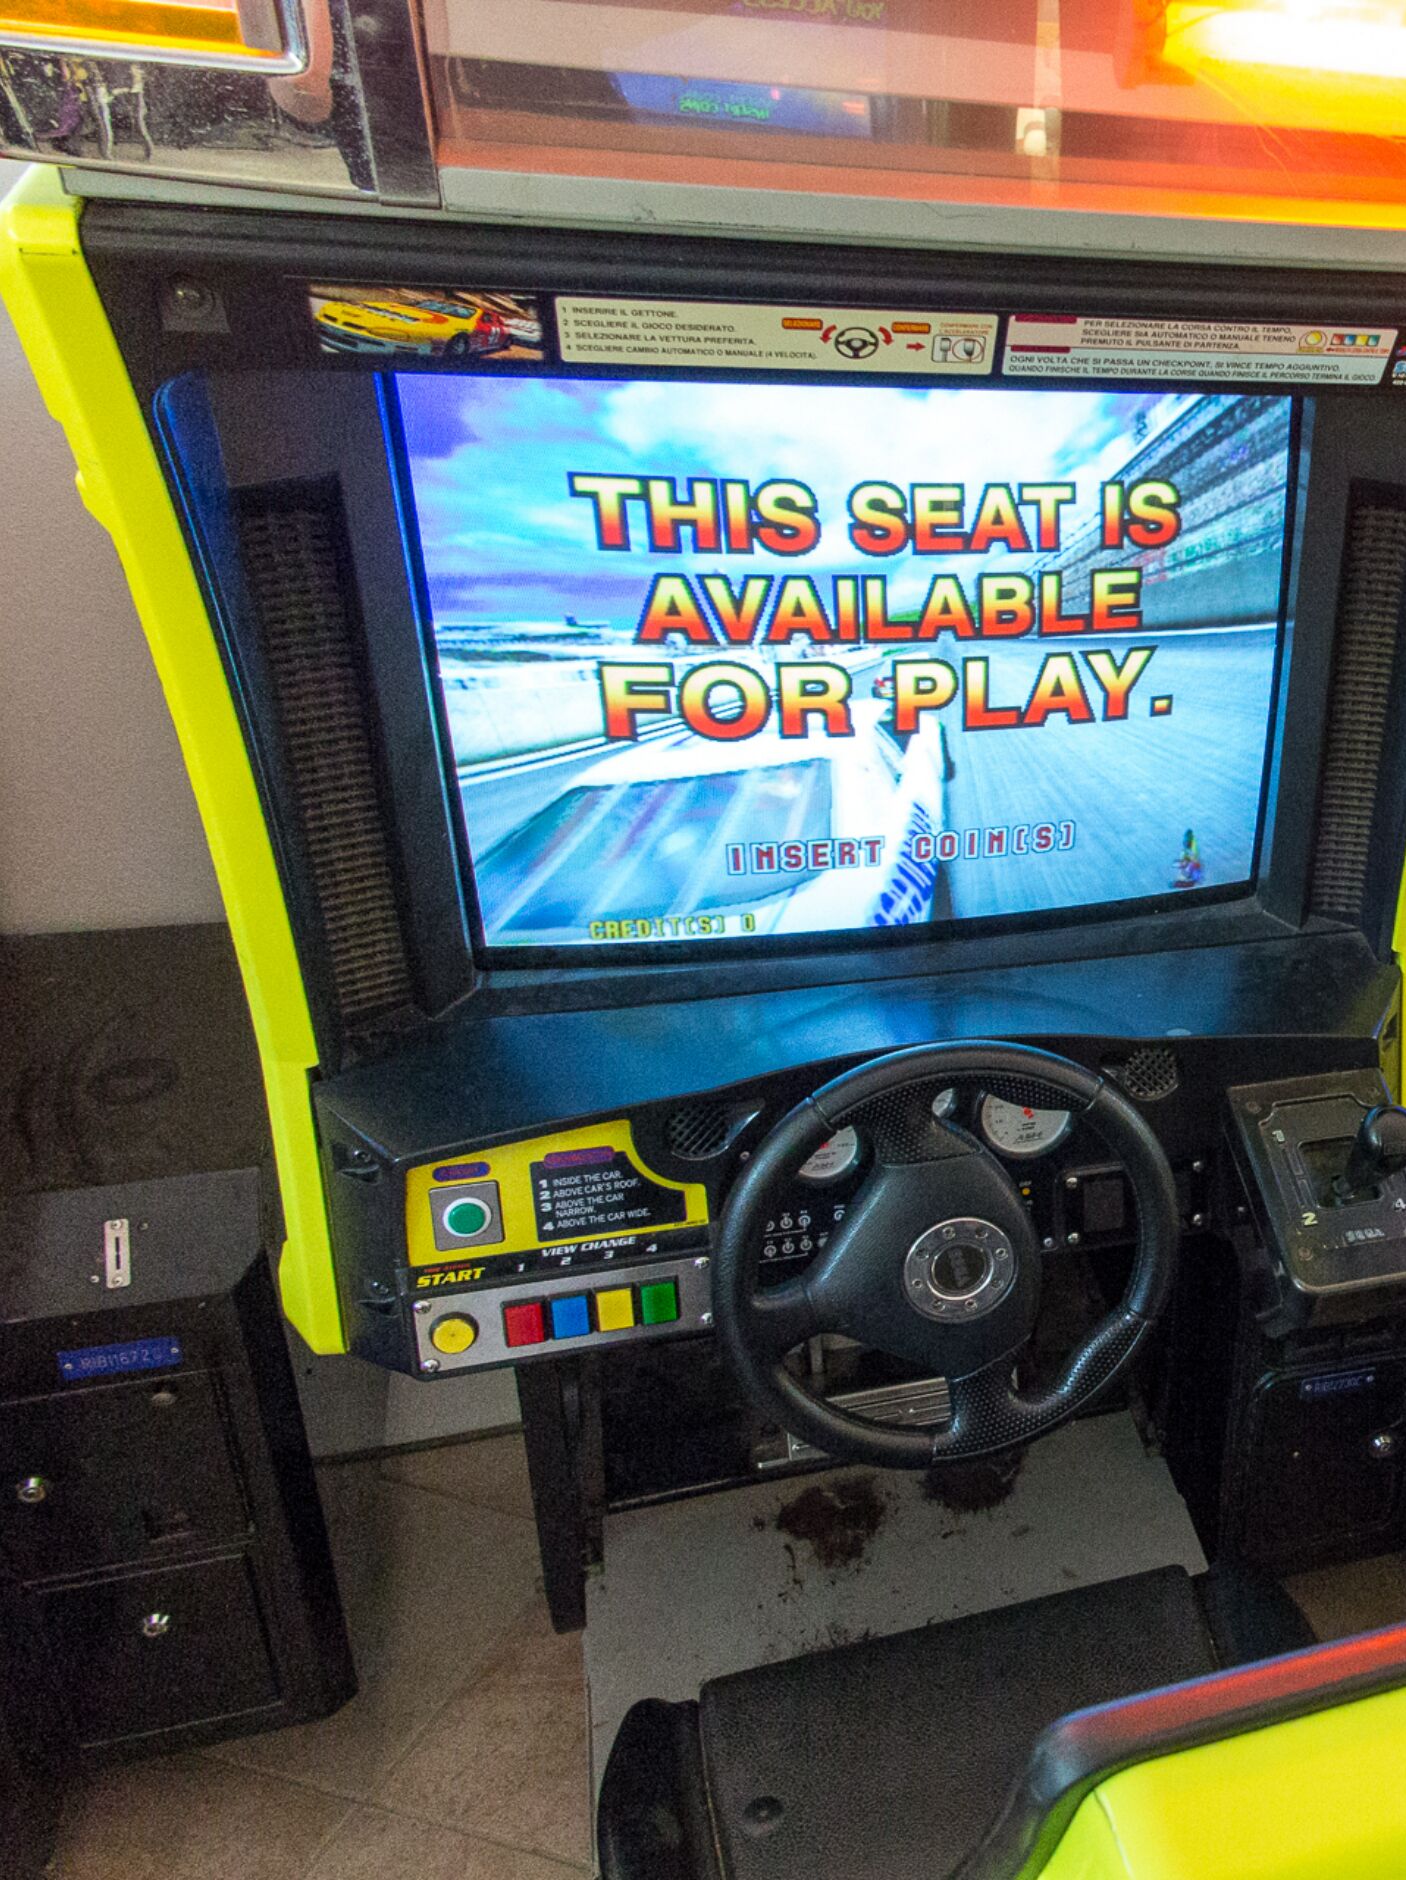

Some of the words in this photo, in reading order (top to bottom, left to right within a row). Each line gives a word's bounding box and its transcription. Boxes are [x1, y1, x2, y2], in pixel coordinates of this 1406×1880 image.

[572, 306, 618, 316] INSERIRE
[574, 320, 628, 329] SCEGLIERE
[642, 322, 673, 330] GIOCO
[1084, 320, 1101, 328] PER
[1105, 320, 1165, 330] SELEZIONARE
[1181, 323, 1212, 332] CORSA
[1214, 324, 1250, 333] CONTRO
[575, 332, 642, 341] SELEZIONARE
[659, 335, 702, 343] VETTURA
[1080, 338, 1125, 346] PREMUTO
[1135, 339, 1181, 348] PULSANTE
[1082, 329, 1133, 337] SCEGLIERE
[1135, 330, 1149, 338] SIA
[1151, 331, 1208, 340] AUTOMATICO
[1219, 333, 1261, 342] MANUALE
[576, 345, 624, 353] SCEGLIERE
[626, 346, 659, 354] CAMBIO
[662, 347, 715, 356] AUTOMATICO
[726, 350, 762, 358] MANUALE
[1010, 355, 1035, 363] OGNI
[1037, 356, 1068, 365] VOLTA
[1070, 357, 1091, 365] CHE
[1103, 358, 1135, 366] PASSA
[1137, 359, 1150, 367] UN
[1215, 361, 1225, 369] SI
[1226, 362, 1254, 370] VINCE
[1255, 362, 1286, 370] TEMPO
[1009, 365, 1044, 373] QUANDO
[1045, 365, 1081, 374] FINISCHE
[1121, 368, 1158, 376] DURANTE
[1171, 369, 1198, 377] CORSE
[1199, 370, 1231, 378] QUANDO
[1232, 371, 1261, 379] FINISCE
[1270, 372, 1311, 380] PERCORSO
[1312, 373, 1343, 381] TERMINA
[568, 470, 821, 556] THIS
[849, 480, 1077, 556] SEAT
[1101, 480, 1182, 551] IS
[635, 566, 1143, 646] AVAILABLE
[600, 659, 854, 743] FOR
[892, 645, 1174, 733] PLAY.
[725, 836, 882, 877] INSERT
[539, 1180, 548, 1189] 1
[553, 1175, 583, 1187] INSIDE
[584, 1174, 600, 1184] THE
[540, 1191, 551, 1200] 2
[553, 1188, 583, 1199] ABOVE
[585, 1184, 613, 1194] CAR'S
[614, 1178, 641, 1190] ROOF.
[541, 1203, 553, 1212] 3
[555, 1198, 585, 1209] ABOVE
[587, 1196, 605, 1206] THE
[606, 1193, 624, 1204] CAR
[556, 1206, 597, 1218] NARROW.
[1302, 1212, 1318, 1227] 2
[543, 1222, 555, 1231] 4
[557, 1218, 589, 1229] ABOVE
[590, 1215, 606, 1225] THE
[607, 1213, 626, 1222] CAR
[541, 1244, 578, 1257] VIEW
[581, 1236, 637, 1252] CHANGE
[517, 1263, 526, 1273] 1
[560, 1257, 572, 1266] 2
[603, 1250, 614, 1260] 3
[647, 1244, 658, 1253] 4
[416, 1267, 486, 1289] START
